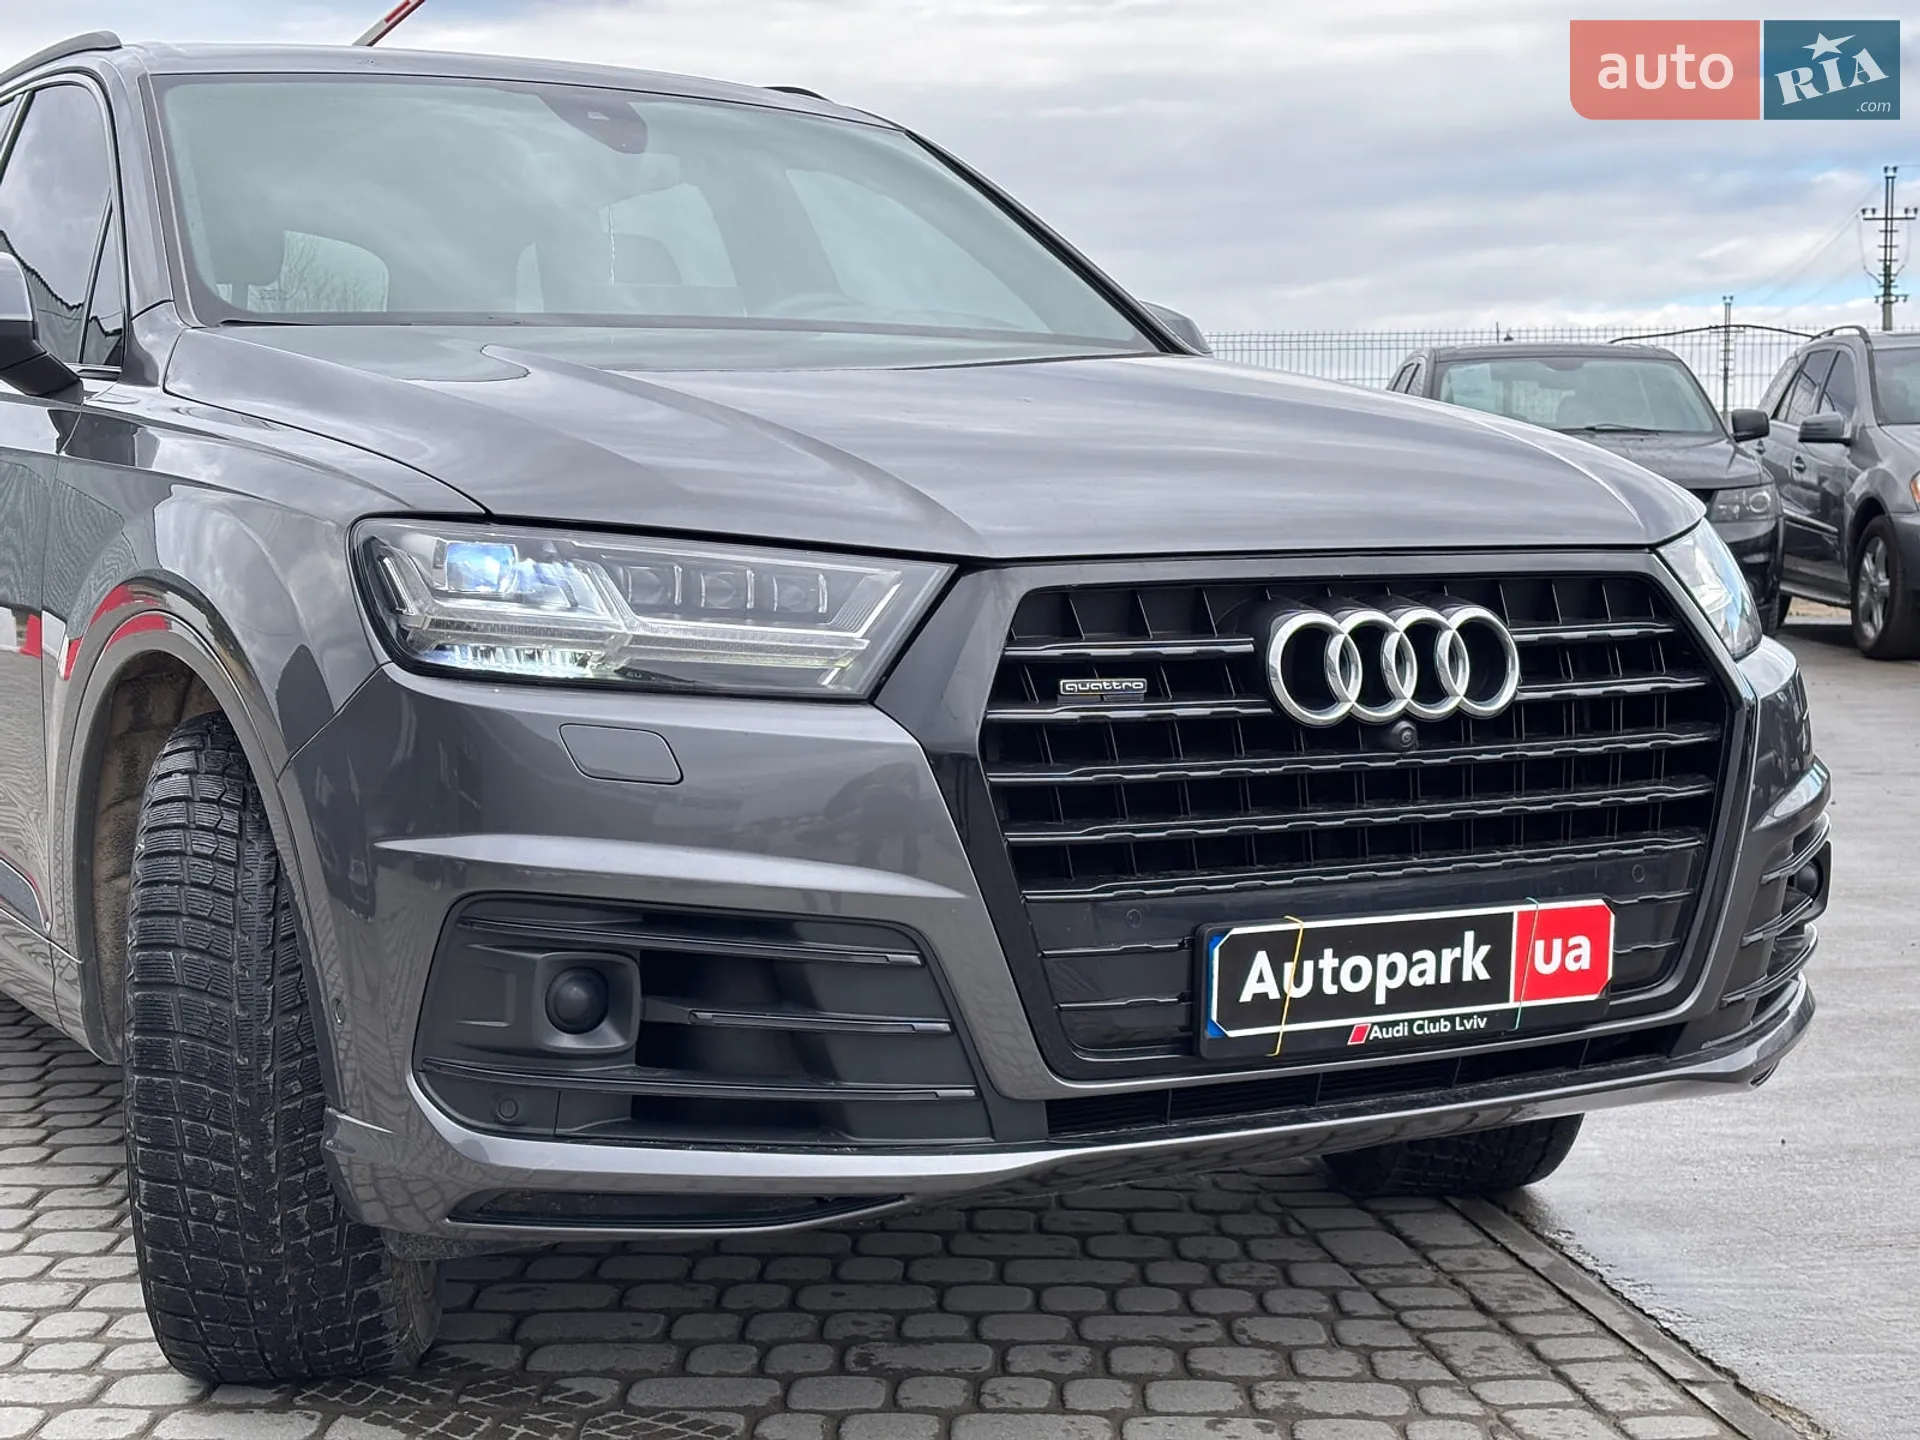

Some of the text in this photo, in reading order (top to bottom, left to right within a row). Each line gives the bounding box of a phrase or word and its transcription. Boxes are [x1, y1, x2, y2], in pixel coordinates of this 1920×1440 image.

[1064, 682, 1144, 693] quattro
[1239, 930, 1592, 1005] Autopark ua
[1369, 1015, 1488, 1040] Audi Club Lviv
